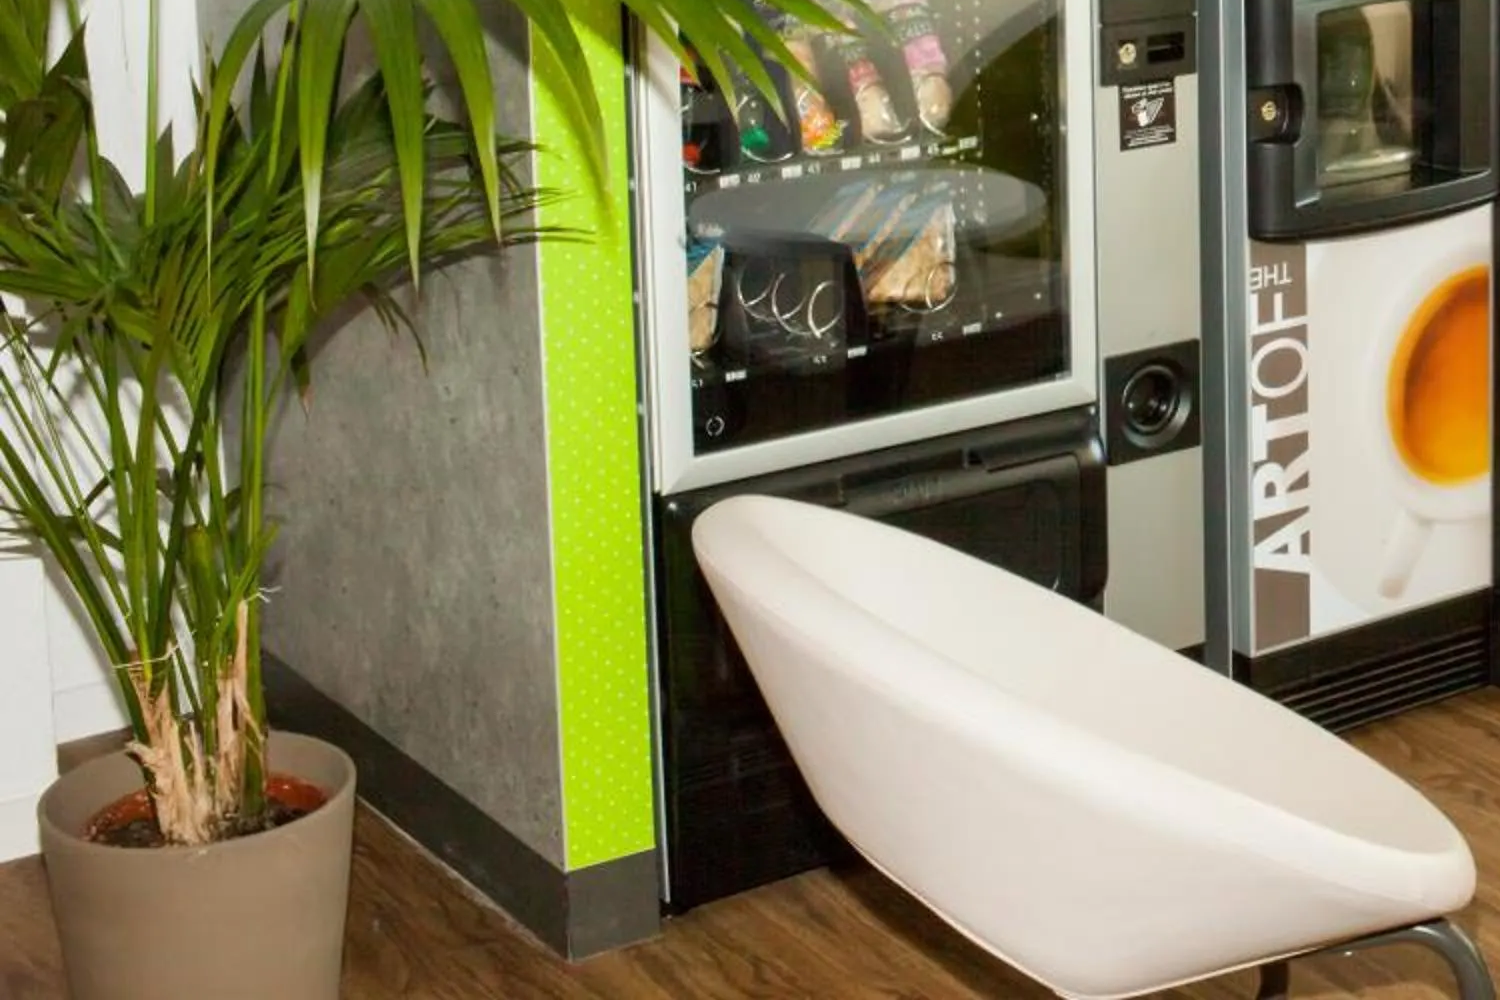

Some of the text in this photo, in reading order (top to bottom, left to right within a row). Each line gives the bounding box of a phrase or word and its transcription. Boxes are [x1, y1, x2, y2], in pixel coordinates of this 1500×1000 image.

[1248, 261, 1293, 290] THE
[1250, 291, 1311, 575] ART OF
